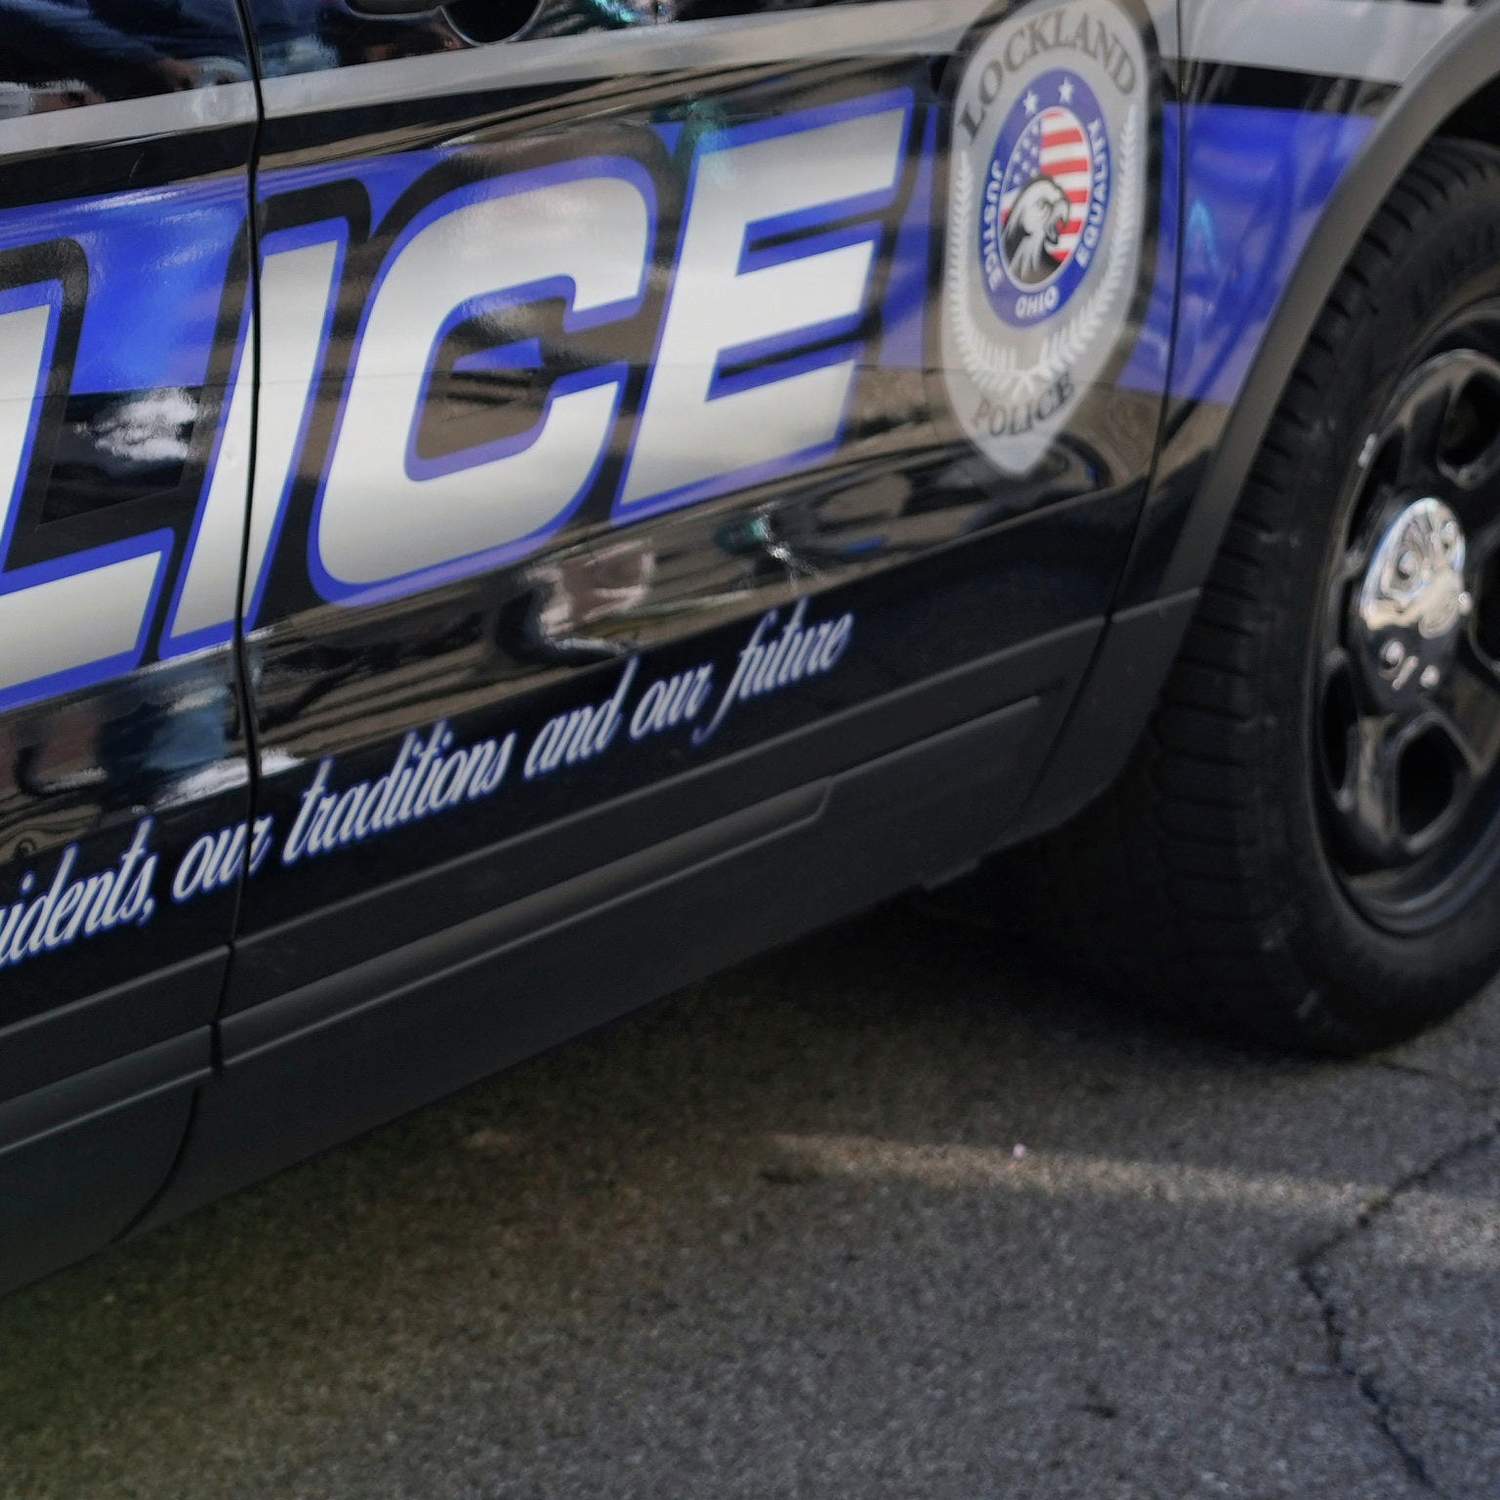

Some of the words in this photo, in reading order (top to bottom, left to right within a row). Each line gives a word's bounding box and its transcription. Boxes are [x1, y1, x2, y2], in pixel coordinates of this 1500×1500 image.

[957, 8, 1137, 146] LOCKLAND
[983, 158, 1003, 292] JUSTICE
[1015, 285, 1060, 320] OHIO
[973, 373, 1075, 437] POLICE
[171, 814, 274, 905] our
[282, 717, 518, 867] traditions
[523, 654, 639, 780] and
[630, 661, 715, 742] our
[692, 596, 854, 747] future
